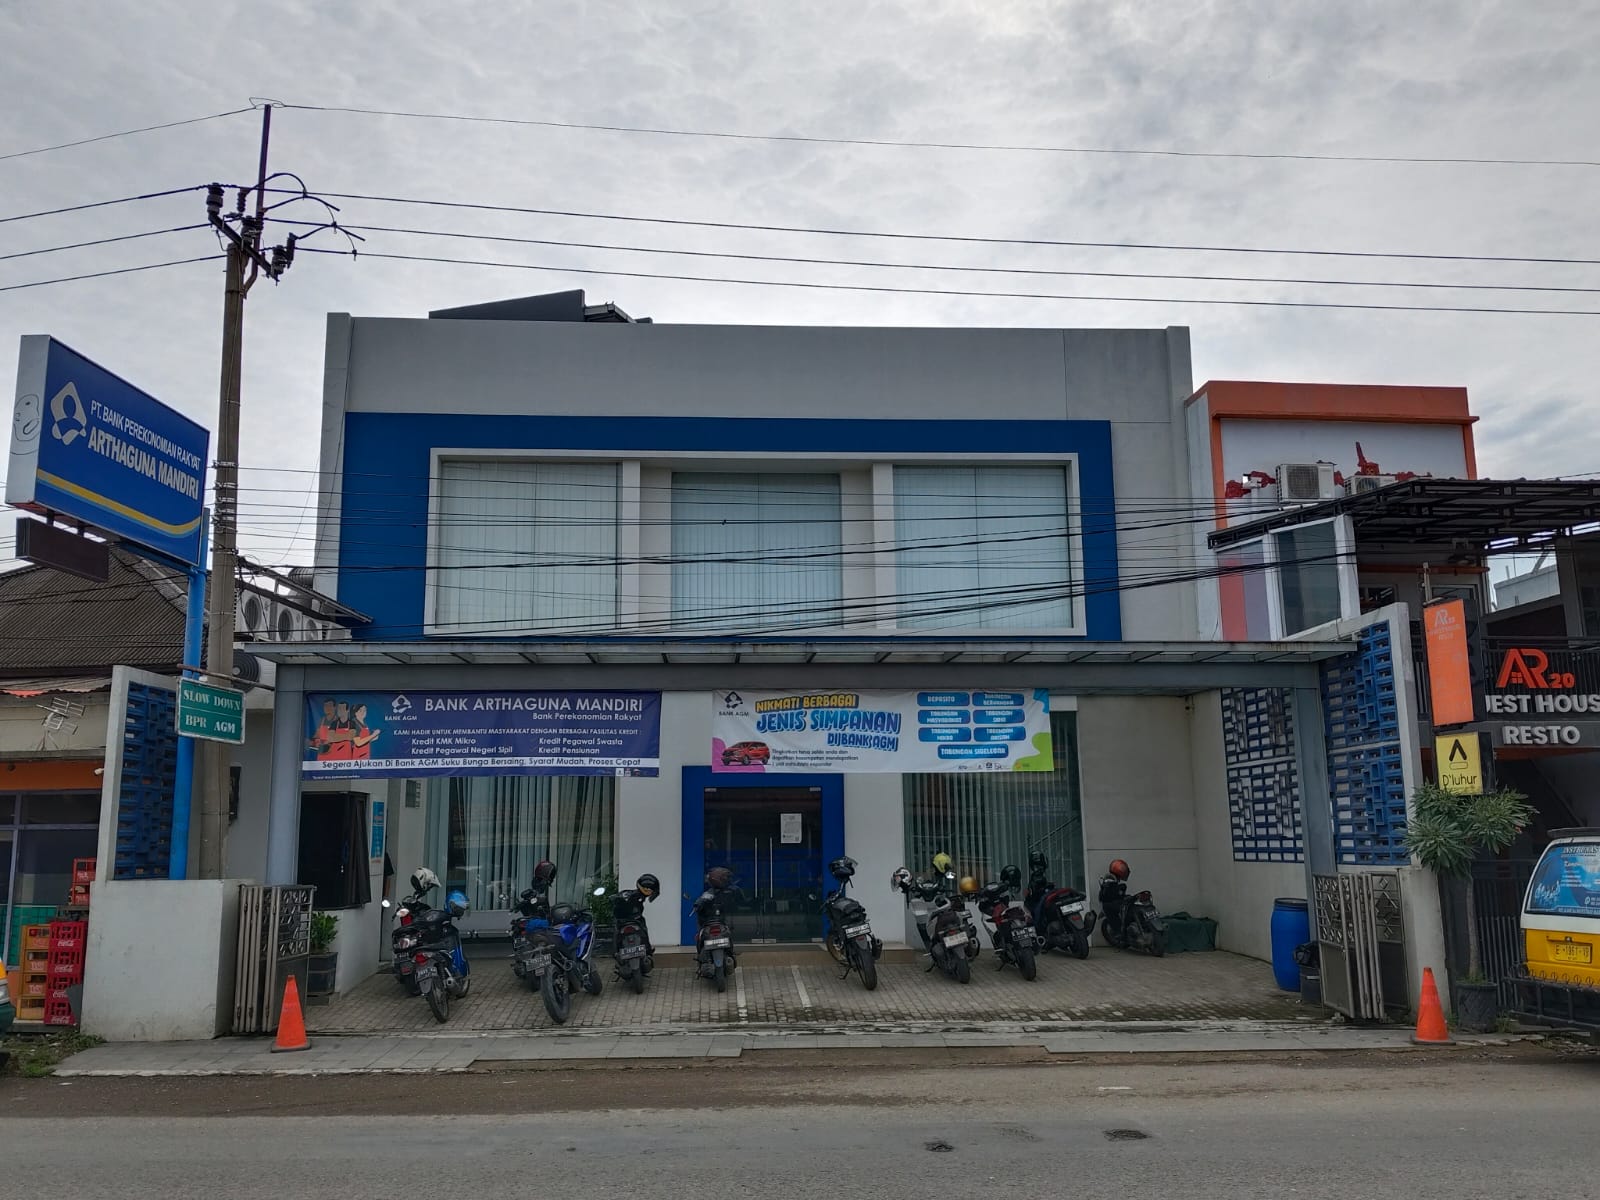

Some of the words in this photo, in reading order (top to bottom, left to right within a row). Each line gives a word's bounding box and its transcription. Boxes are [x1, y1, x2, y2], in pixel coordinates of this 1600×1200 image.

[90, 399, 102, 420] PT.
[102, 405, 125, 430] BANK
[124, 417, 177, 458] PEREKONOMIAN
[176, 446, 202, 471] RAKYAT
[88, 426, 157, 480] ARTHAGUNA
[158, 460, 200, 501] MANDIRI
[183, 689, 210, 704] SLOW
[214, 696, 240, 711] DOWN
[424, 698, 468, 712] BANK
[472, 698, 571, 712] ARTHAGUNA
[576, 698, 643, 712] MANDIRI
[755, 698, 801, 712] NIKMATI
[802, 694, 857, 708] BERBAGAI
[1486, 694, 1531, 713] EST
[1535, 694, 1600, 713] HOUS
[185, 714, 207, 728] BPR
[214, 720, 236, 734] AGM
[614, 713, 642, 721] Rakyat
[756, 712, 806, 732] JENIS
[810, 710, 901, 734] SIMPANAN
[563, 738, 595, 746] Pegawai
[873, 735, 898, 751] AGM
[1502, 726, 1580, 744] RESTO
[435, 748, 469, 756] Pegawai
[471, 747, 497, 755] Negeri
[498, 746, 513, 754] Sipil
[322, 761, 352, 769] Segera
[354, 760, 383, 768] Ajukan
[463, 758, 489, 768] Bunga
[528, 758, 554, 766] Syarat
[615, 758, 641, 767] Cepat
